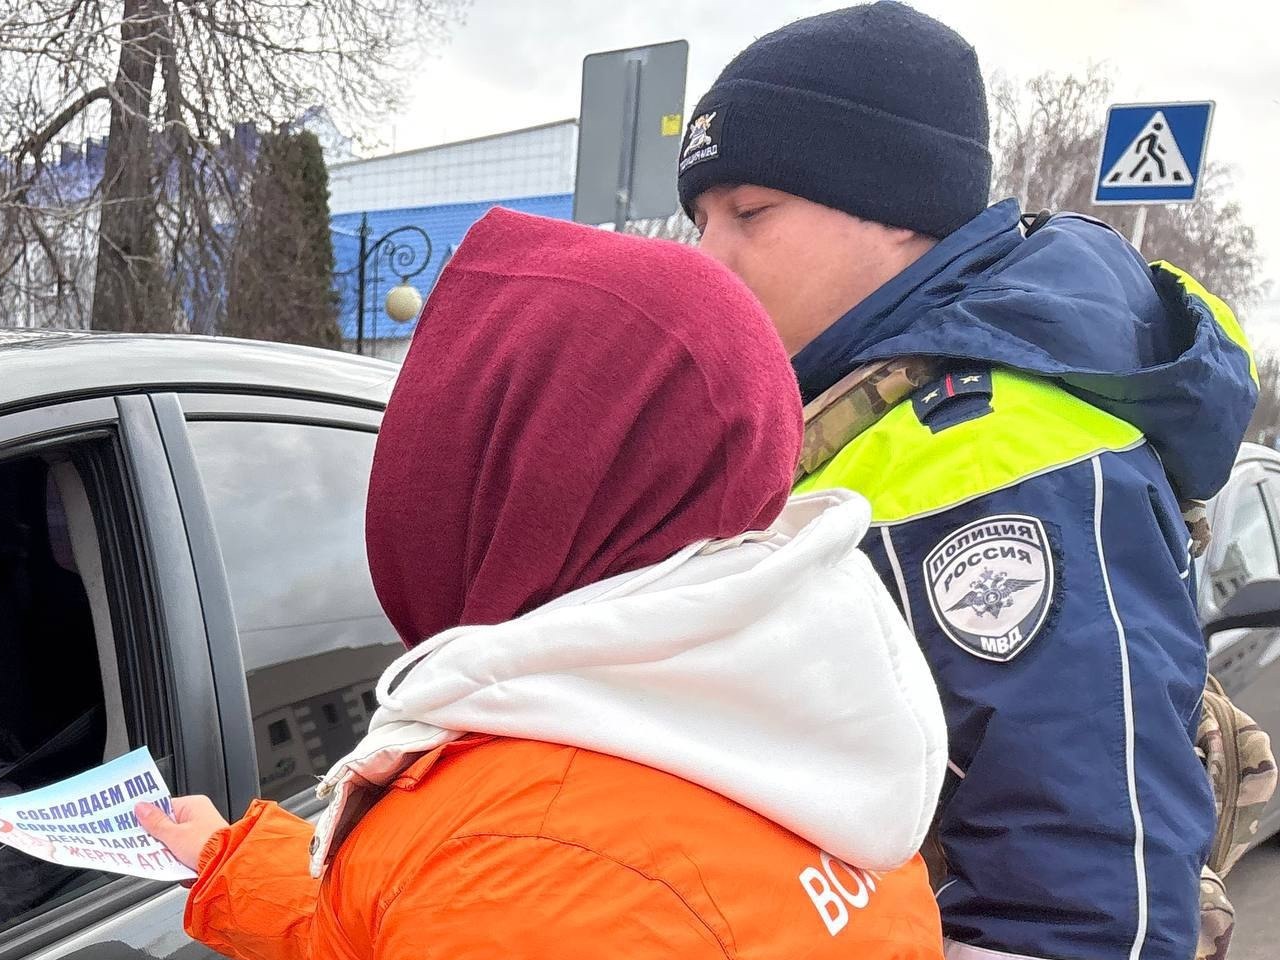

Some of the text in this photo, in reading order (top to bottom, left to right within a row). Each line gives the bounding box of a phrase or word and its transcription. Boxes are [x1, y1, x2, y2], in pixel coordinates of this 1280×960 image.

[933, 524, 1033, 573] ПОЛИЦИЯ
[944, 547, 1032, 592] РОССИЯ
[980, 626, 1022, 653] МВД
[16, 771, 160, 821] СОБЛЮДАЕМ ППД
[16, 819, 114, 835] СОХРАНЯЕМ
[46, 833, 95, 846] ДЕНЬ
